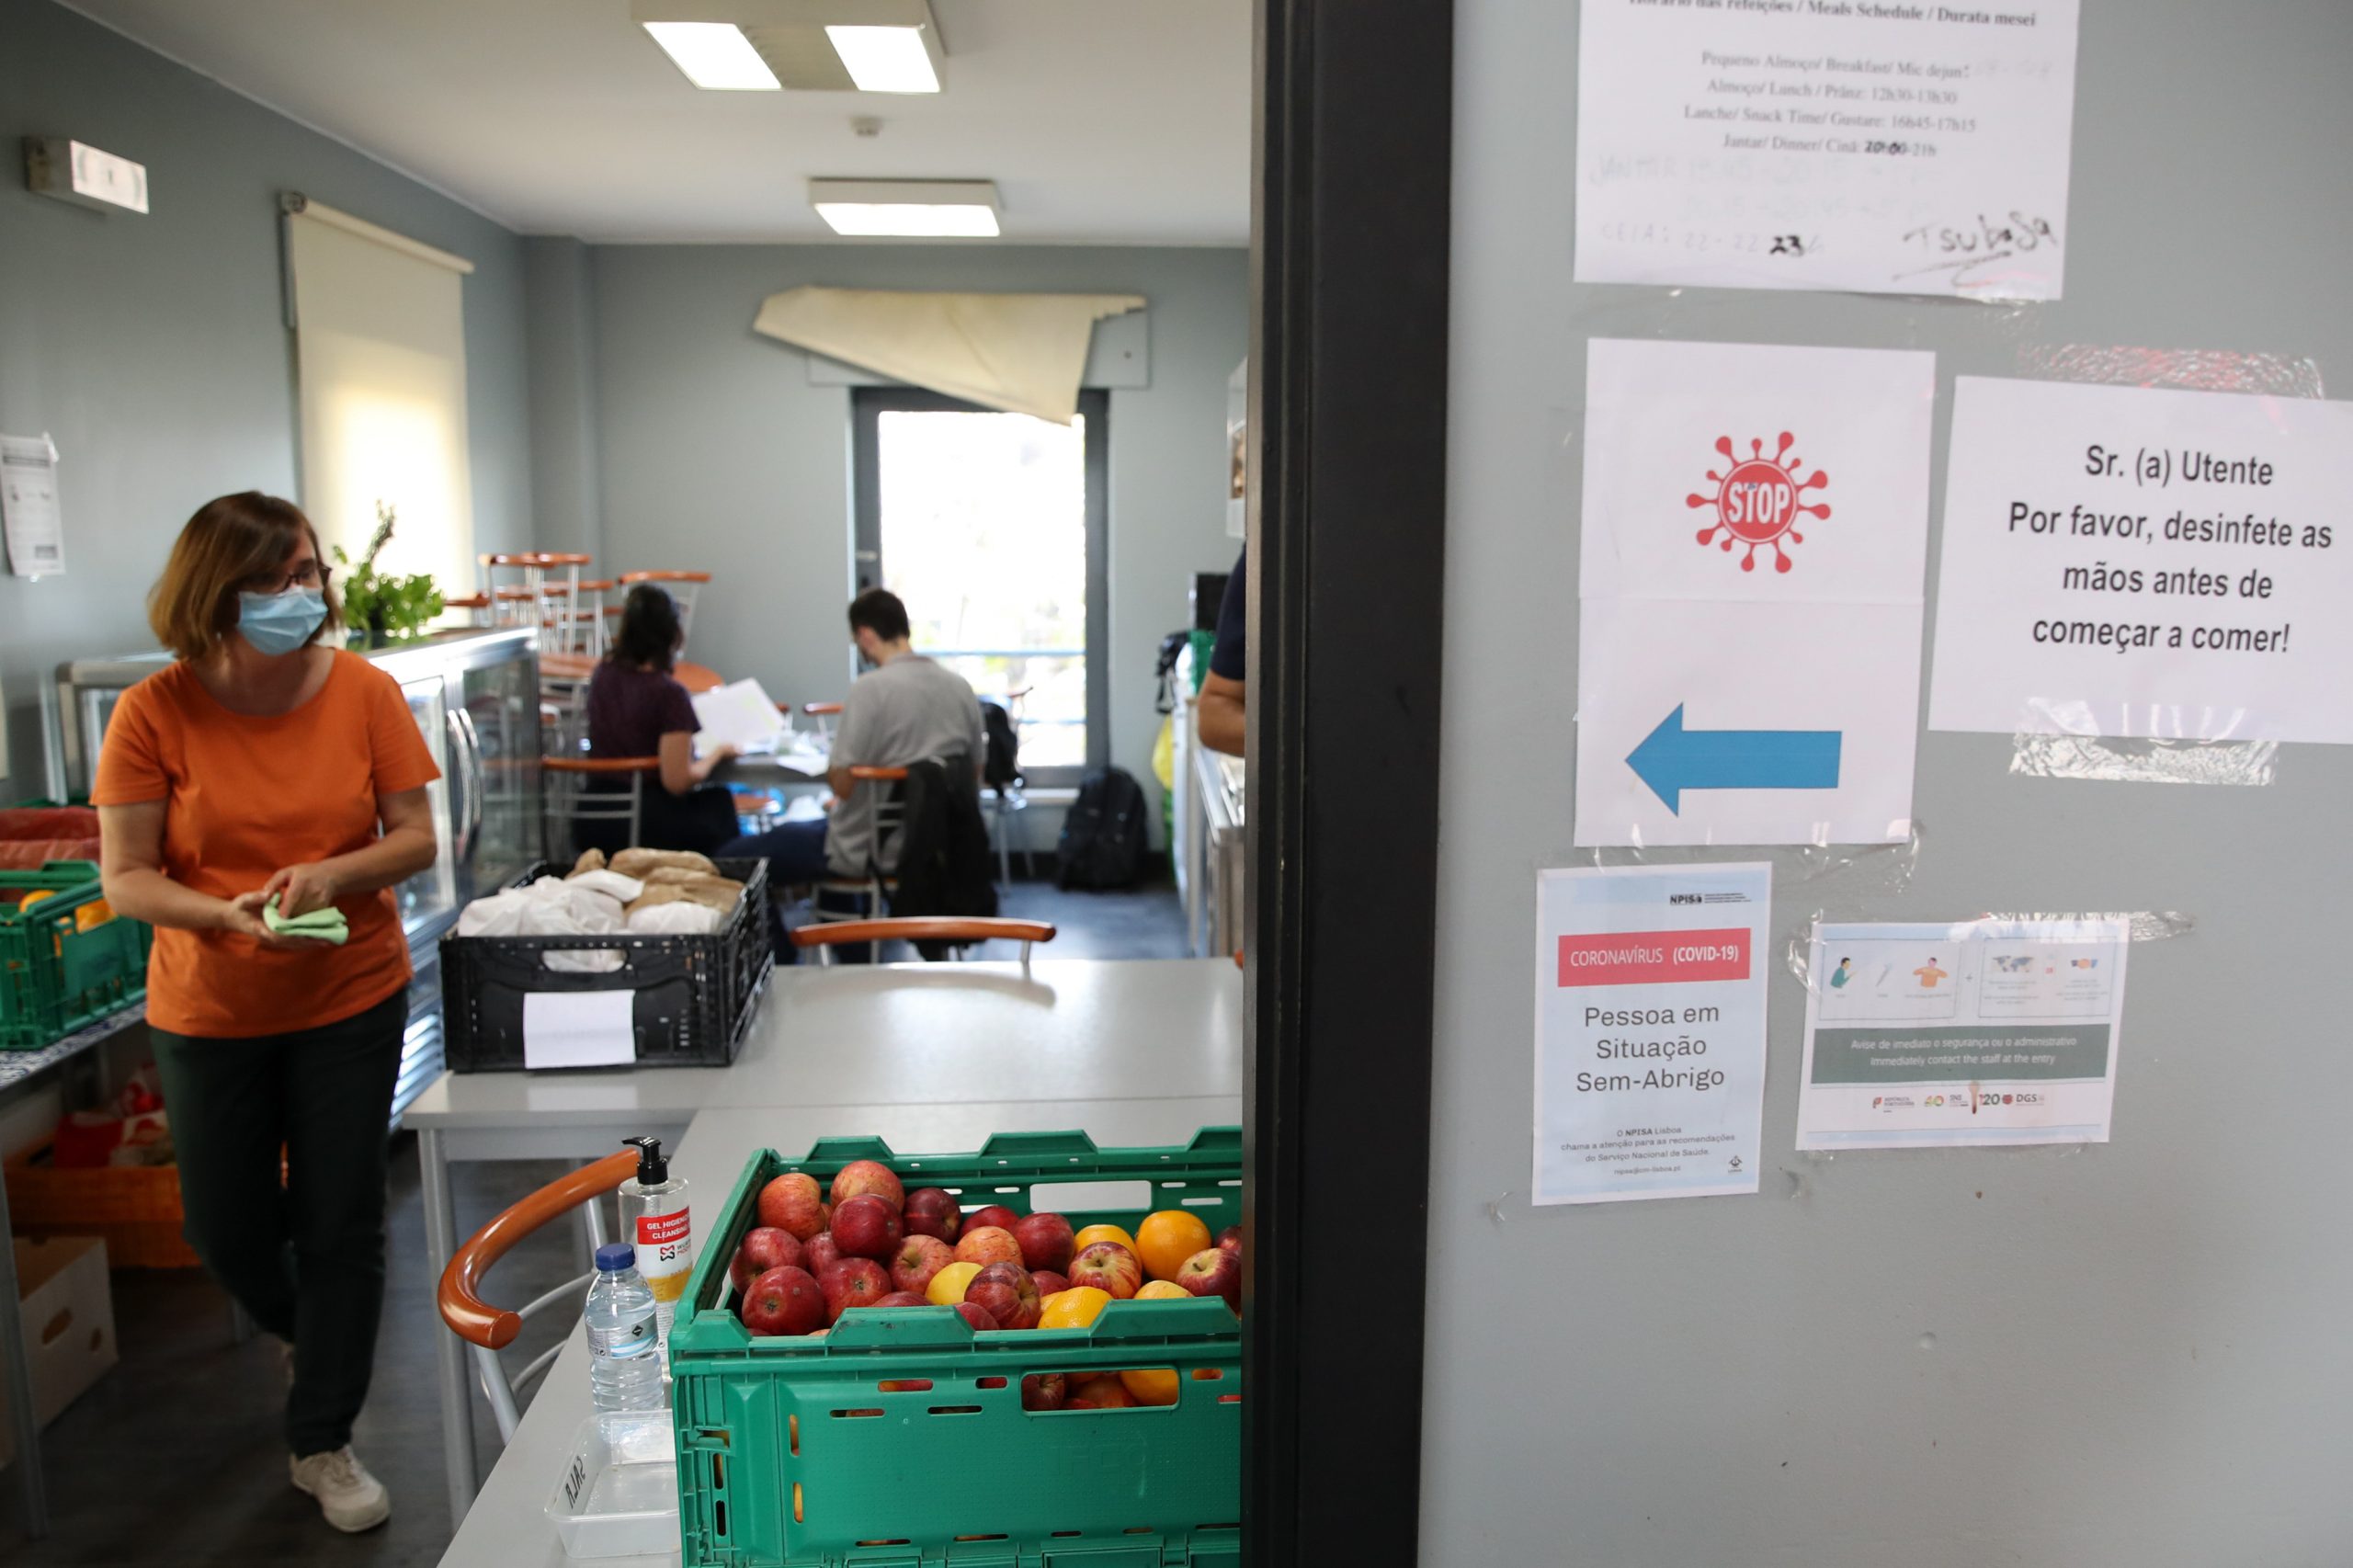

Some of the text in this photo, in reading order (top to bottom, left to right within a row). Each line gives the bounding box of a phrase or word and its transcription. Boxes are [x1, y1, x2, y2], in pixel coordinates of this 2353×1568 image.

[1808, 0, 1851, 16] Meals
[1856, 4, 1923, 20] Schedule
[1937, 7, 1989, 24] Durata
[1994, 13, 2036, 26] mesei
[1702, 51, 1759, 69] Pequeno
[1896, 62, 1922, 76] Mic
[1769, 81, 1811, 96] Lunch
[1743, 108, 1781, 122] Snack
[2085, 445, 2273, 487] Sr. (a) Utente
[1727, 481, 1790, 524] STOP
[2008, 502, 2332, 548] Por favor, desinfete as
[2063, 562, 2273, 599] mãos antes de
[2032, 619, 2290, 653] começar a comer!
[1571, 944, 1739, 967] CORONAVÍRUS (COVID-19)
[1585, 1006, 1720, 1028] Pessoa em
[1597, 1036, 1706, 1062] Situação
[1851, 1040, 1875, 1049] Avise
[1878, 1040, 1891, 1049] de
[1893, 1039, 1931, 1049] imediato
[1942, 1039, 1989, 1049] segurança
[2014, 1037, 2077, 1047] administrativo
[1927, 1055, 1961, 1064] contact
[1962, 1054, 1977, 1063] the
[1981, 1053, 2002, 1063] staff
[2003, 1054, 2012, 1063] at
[2014, 1053, 2029, 1063] the
[2031, 1054, 2056, 1065] entry
[1576, 1069, 1725, 1092] Sem-Abrigo
[1561, 1142, 1590, 1151] chama
[1599, 1139, 1632, 1150] atenção
[1635, 1140, 1654, 1148] para
[1668, 1134, 1735, 1145] recomendações
[1654, 1127, 1682, 1135] Lisboa
[1598, 1153, 1630, 1162] Serviço
[1631, 1151, 1667, 1160] Nacional
